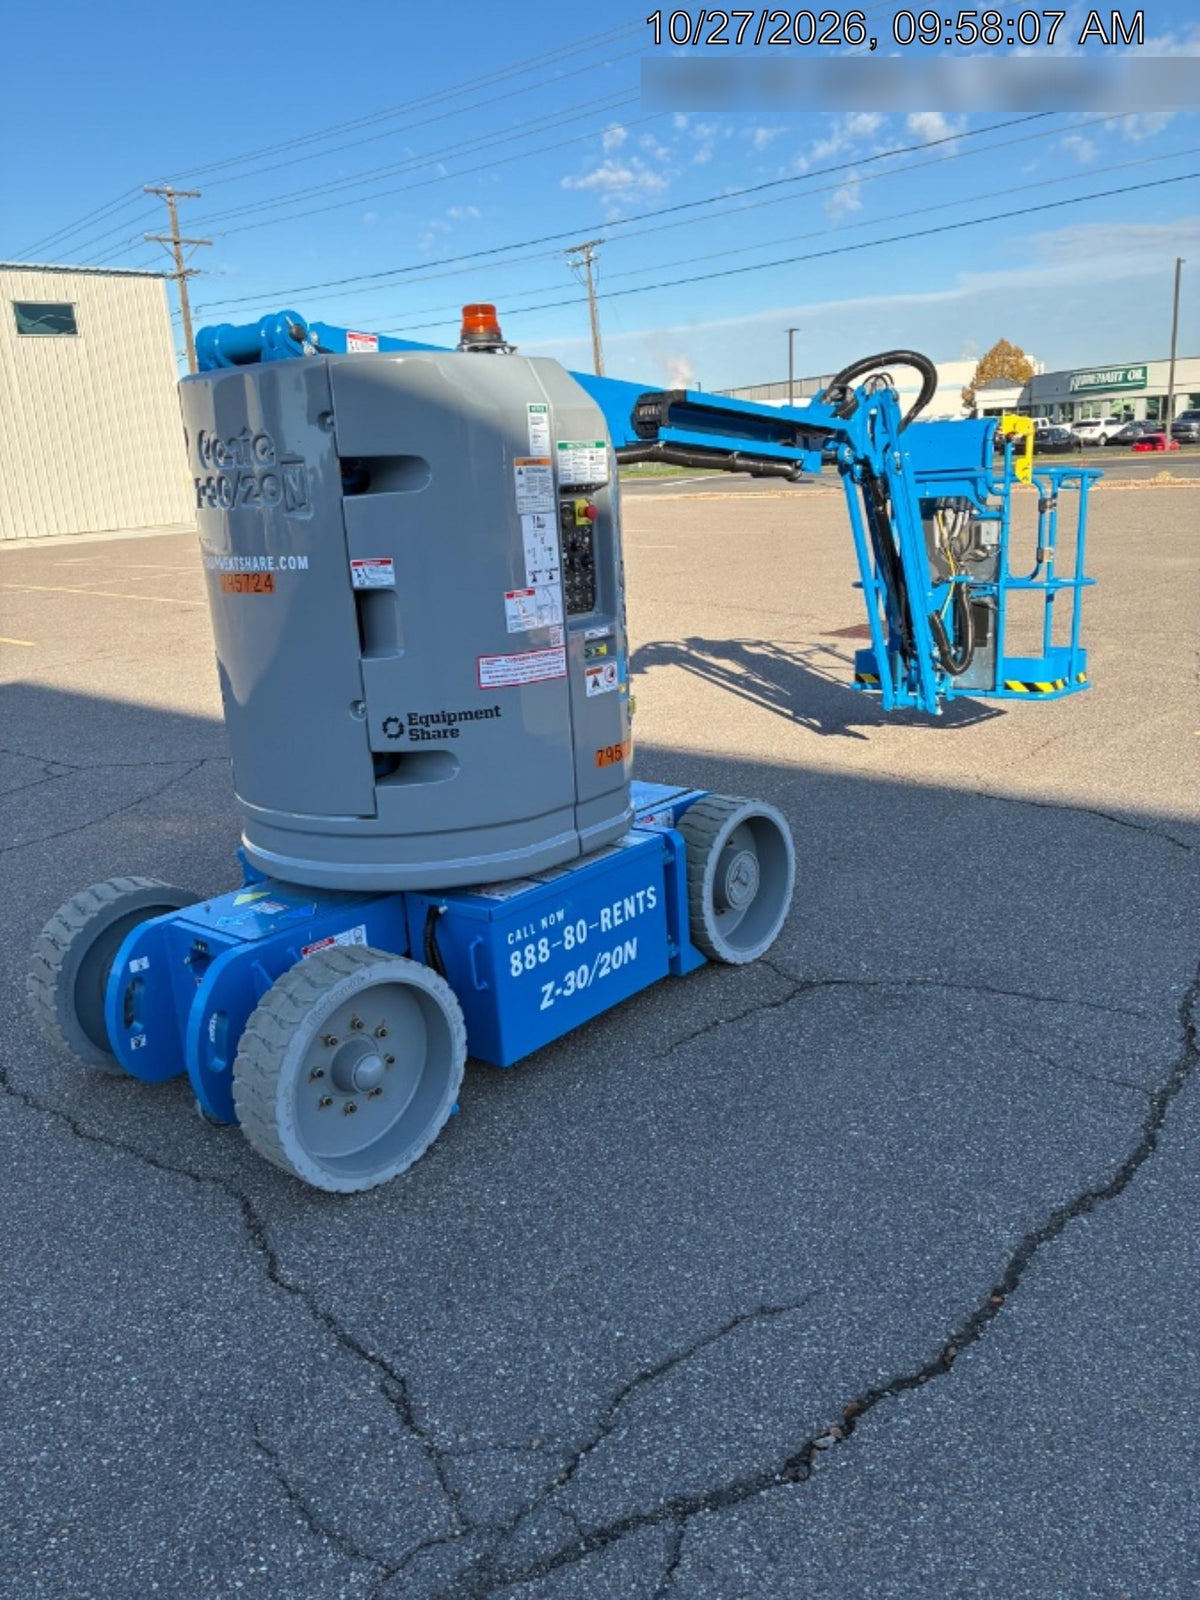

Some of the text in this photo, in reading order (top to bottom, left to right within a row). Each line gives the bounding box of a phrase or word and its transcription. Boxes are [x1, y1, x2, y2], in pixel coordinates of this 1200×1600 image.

[407, 705, 502, 728] Equipment
[409, 728, 460, 742] Share
[507, 908, 565, 945] CALL NOW
[509, 885, 657, 978] 888-80-RENTS
[540, 936, 638, 1011] Z-30/20N
